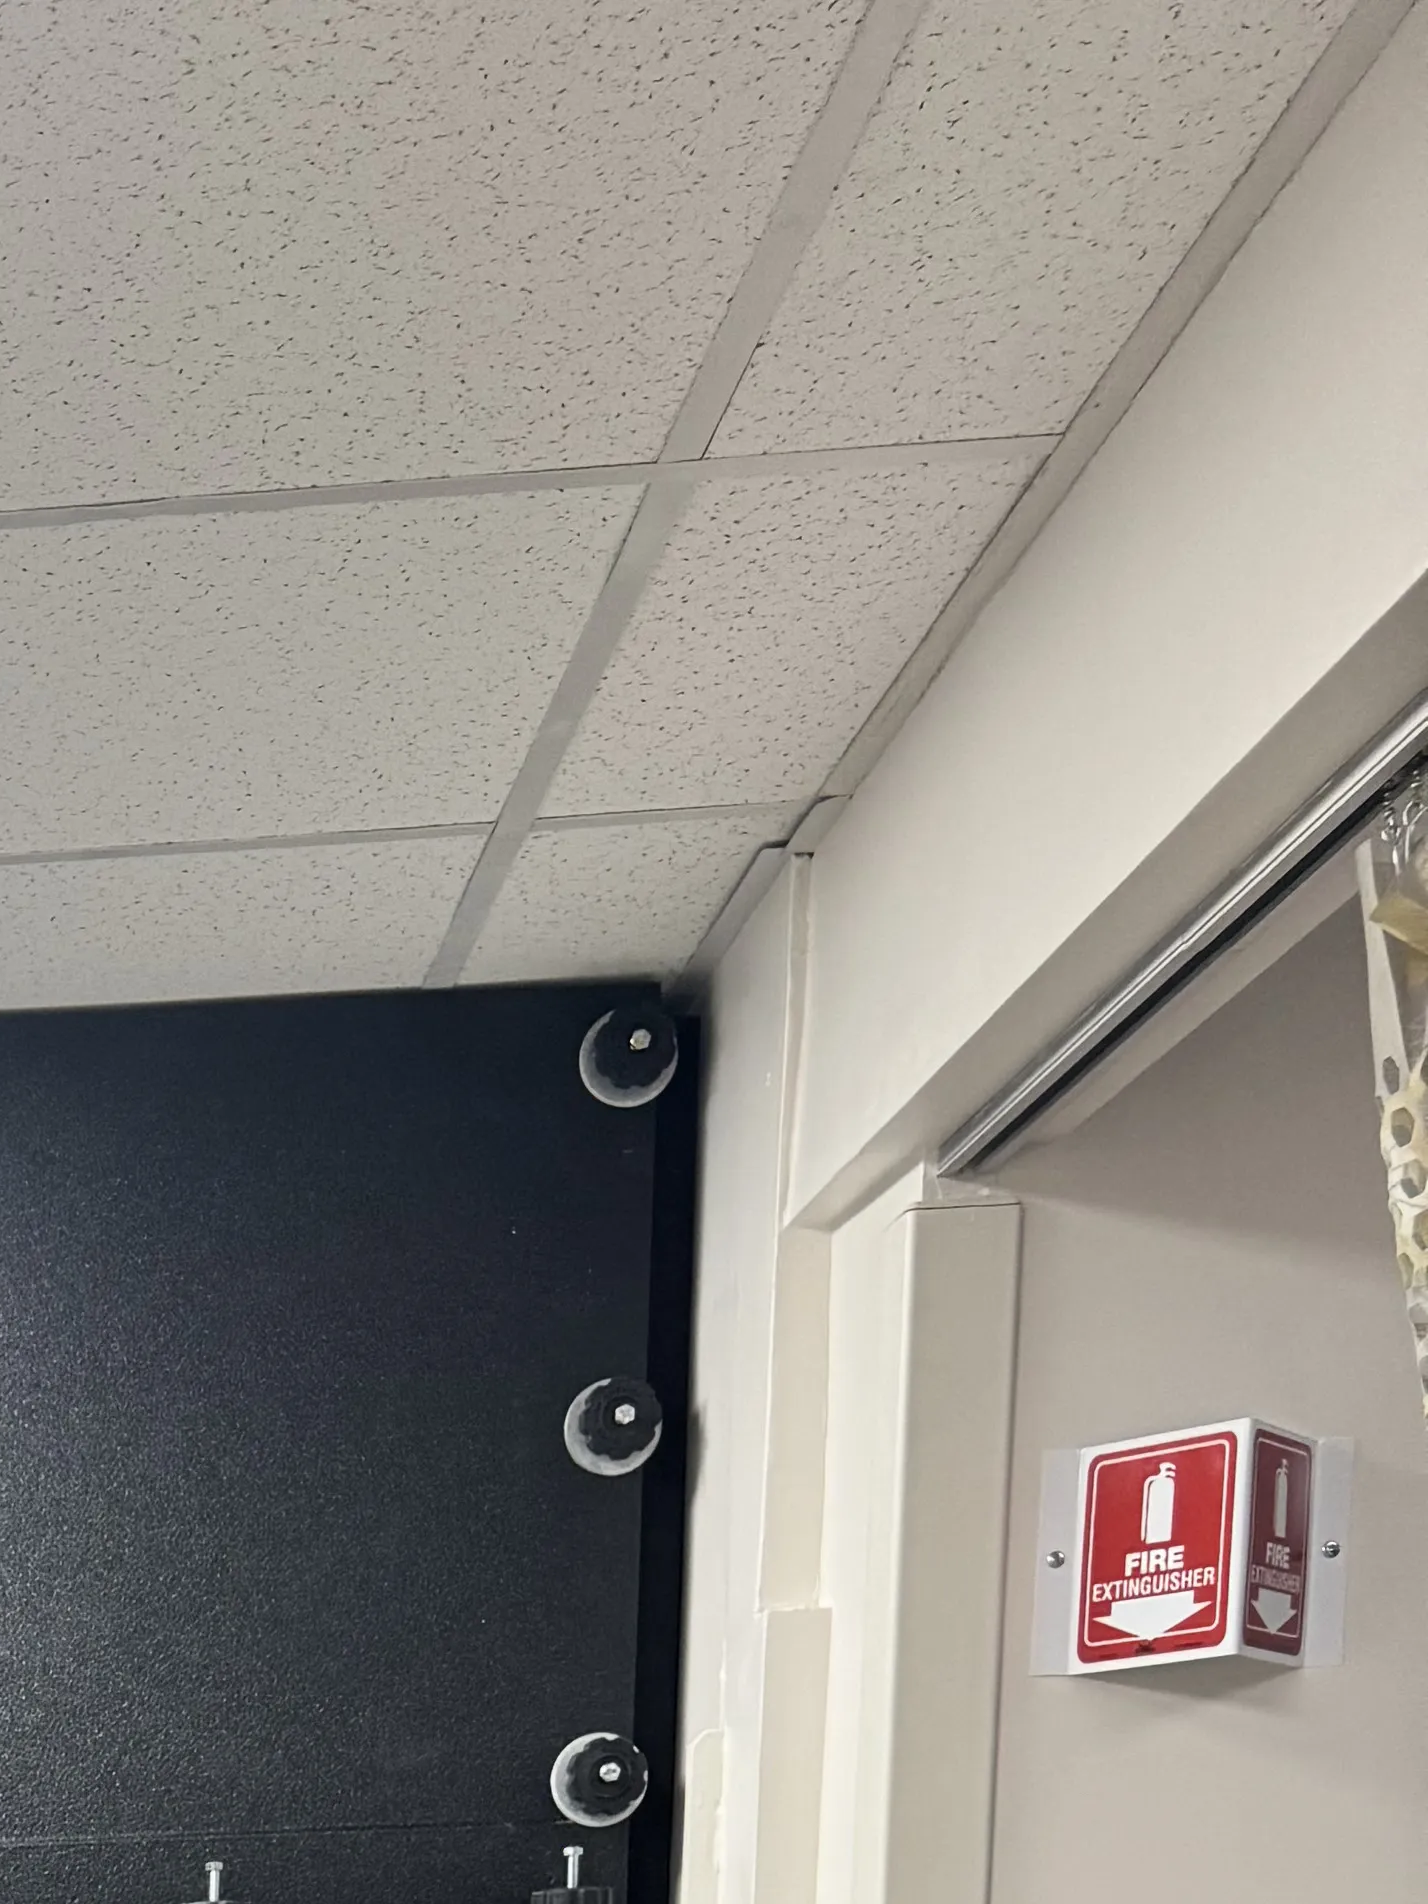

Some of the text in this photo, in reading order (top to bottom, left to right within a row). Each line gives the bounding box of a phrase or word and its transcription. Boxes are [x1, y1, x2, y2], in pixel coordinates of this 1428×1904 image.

[1124, 1545, 1185, 1577] FIRE
[1265, 1542, 1291, 1570] FIRE
[1092, 1566, 1216, 1603] EXTINGUISHER
